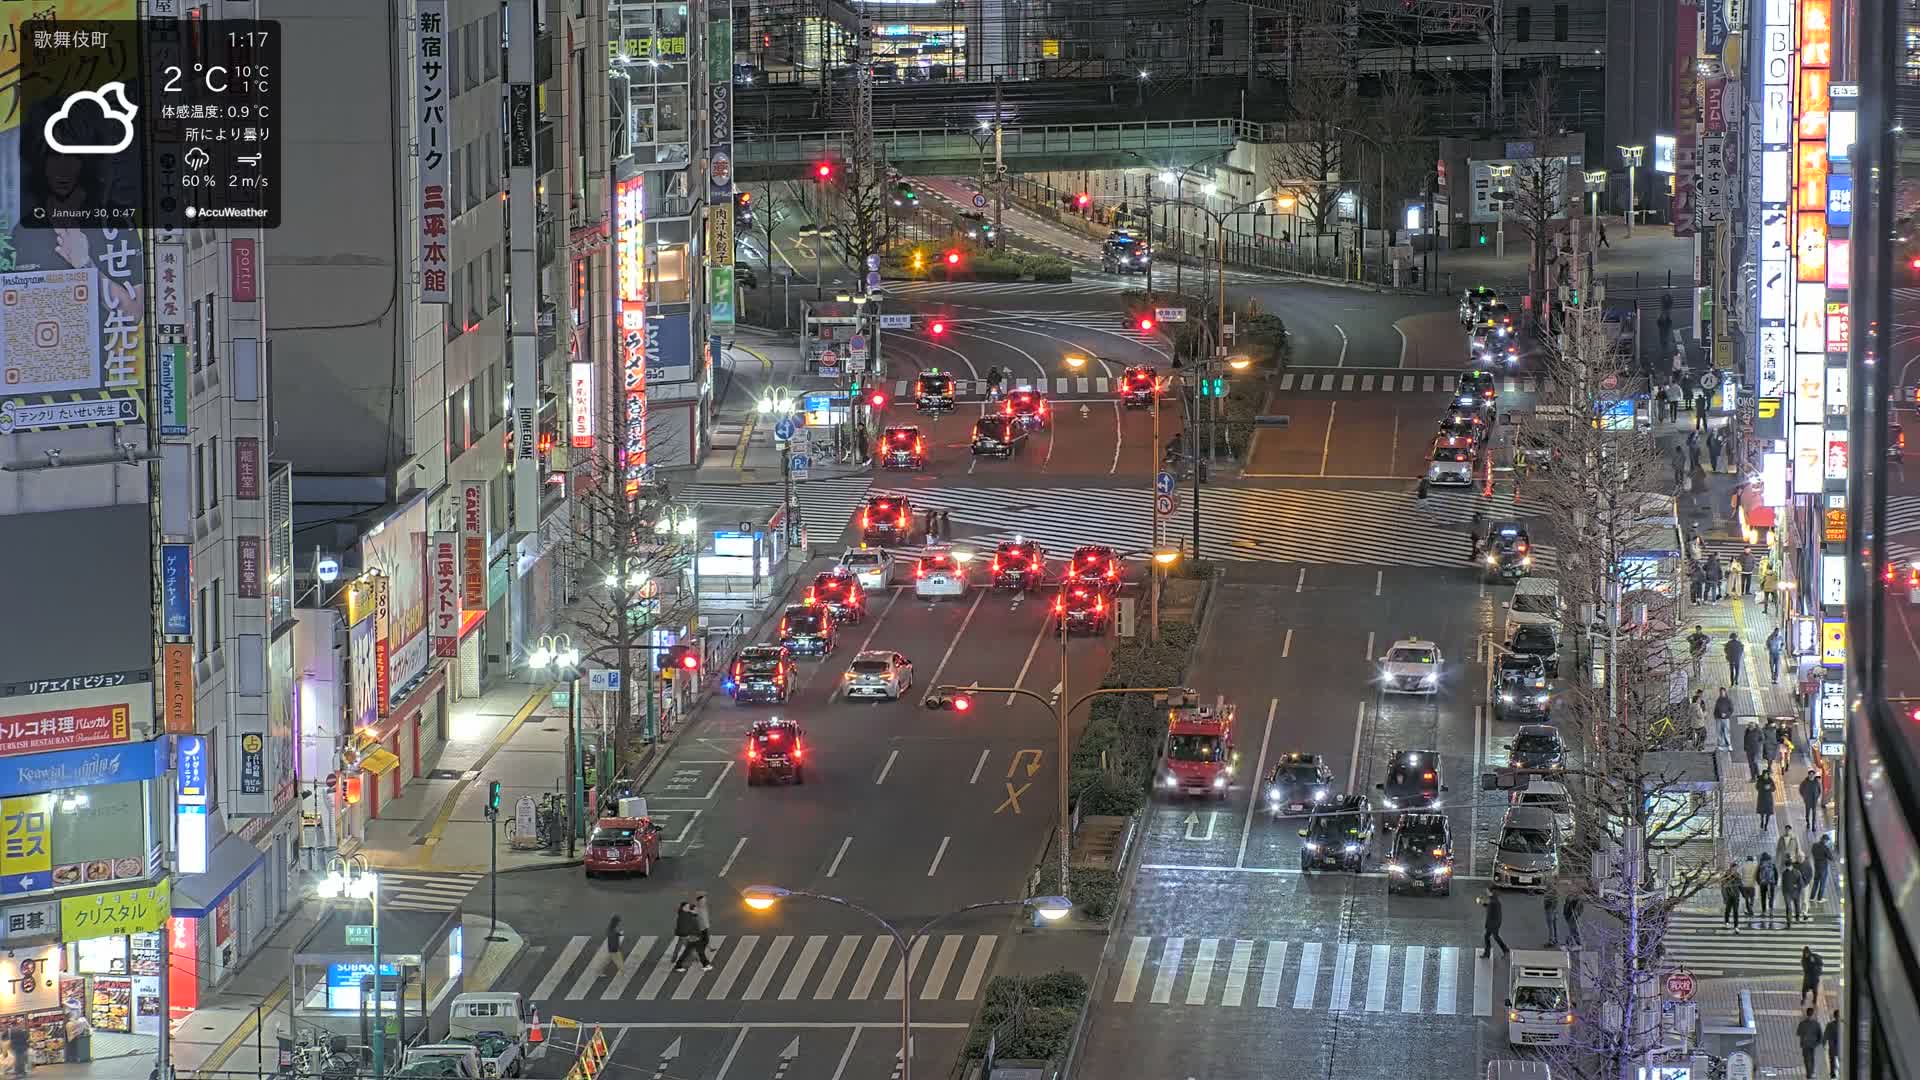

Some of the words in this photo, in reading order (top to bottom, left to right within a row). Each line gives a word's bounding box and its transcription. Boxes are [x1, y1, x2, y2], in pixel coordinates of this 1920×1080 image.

[420, 11, 444, 170] 新宿サンパーク
[423, 185, 447, 293] 三平本館
[715, 208, 729, 263] 肉汁水餃子
[0, 275, 45, 288] Instagram
[715, 276, 729, 314] レイク
[163, 325, 180, 334] 3F
[625, 332, 641, 388] ラーメン
[161, 354, 174, 415] FamilyMart
[20, 411, 54, 423] テンクリ
[59, 405, 116, 419] たいせい先生
[519, 407, 532, 460] HOMEGAME
[466, 487, 478, 532] GAME
[166, 555, 178, 606] ゲウチャイ
[438, 543, 454, 629] 三平ストア
[29, 673, 125, 694] リアエイドビジョン
[0, 716, 75, 739] トルコ料理
[30, 735, 75, 748] RESTAURANT
[9, 911, 45, 933] 囲碁
[75, 904, 147, 927] クリスタル
[336, 962, 390, 972] SUBNAE
